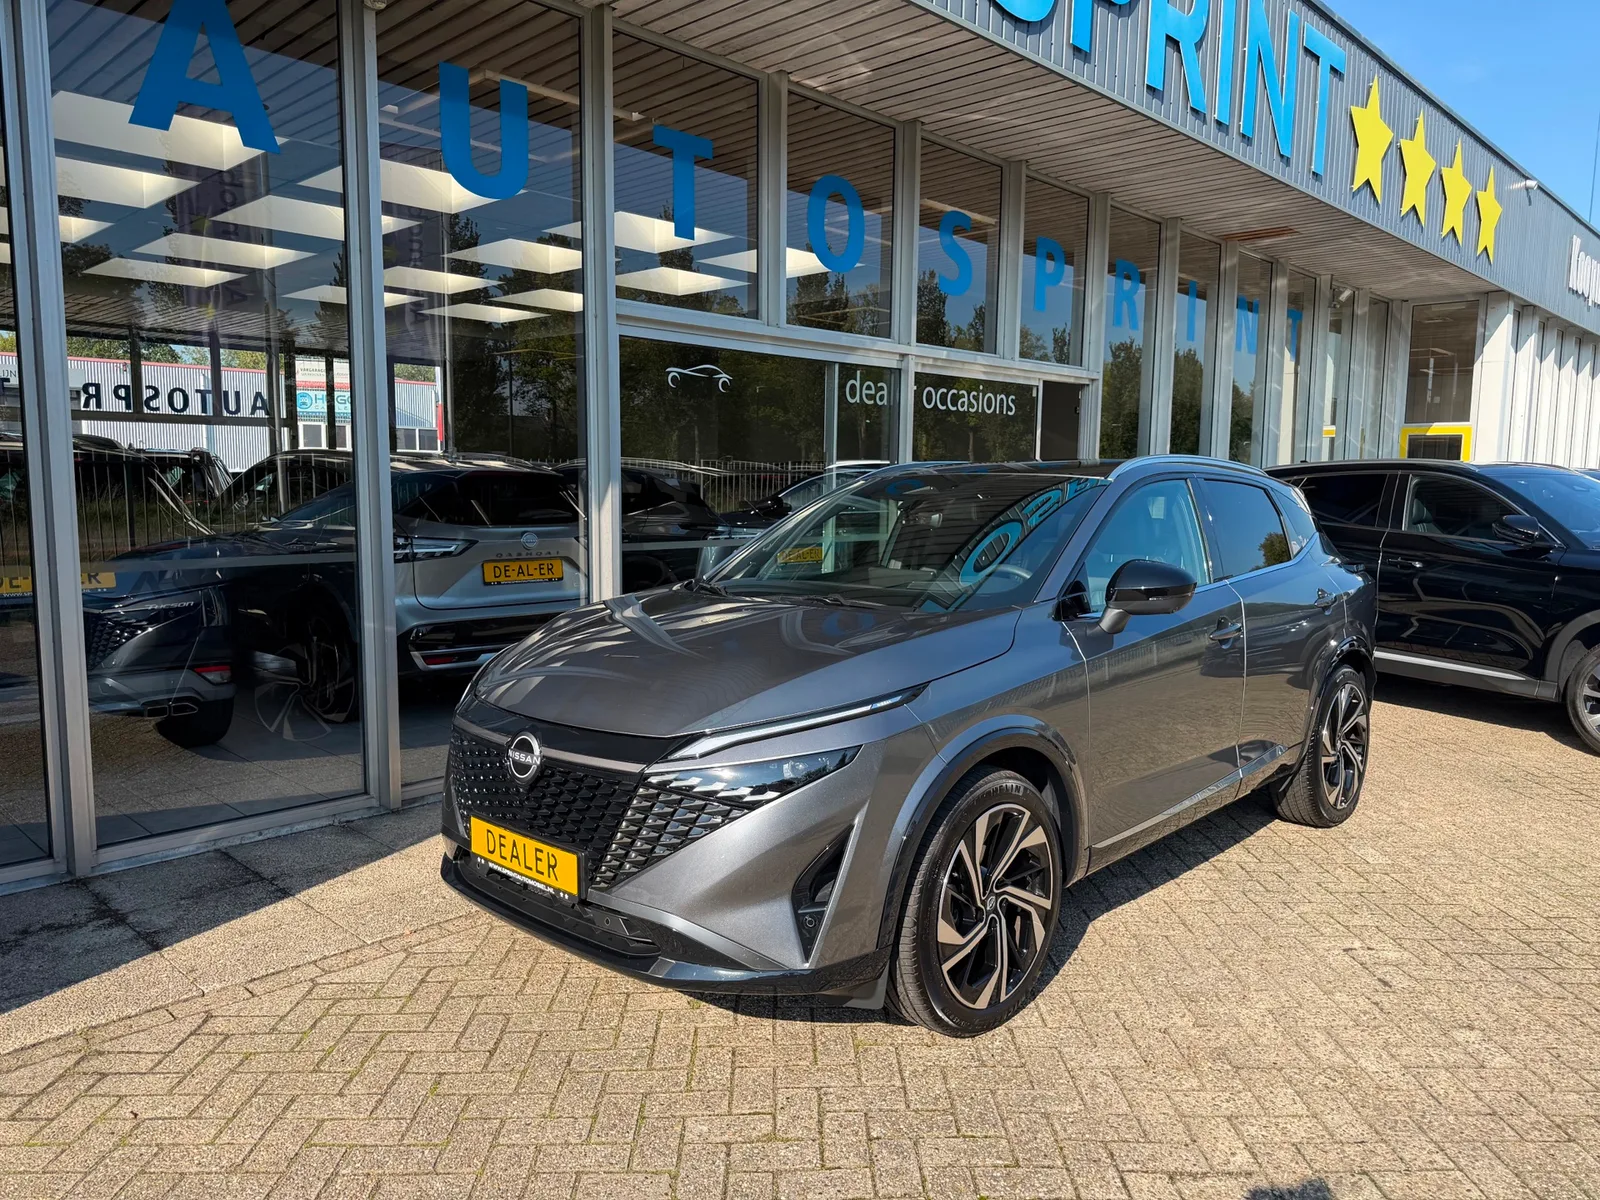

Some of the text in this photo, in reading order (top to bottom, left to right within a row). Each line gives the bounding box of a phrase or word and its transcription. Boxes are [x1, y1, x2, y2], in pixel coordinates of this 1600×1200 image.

[996, 0, 1345, 176] RINT
[923, 385, 1015, 415] occasions
[493, 563, 555, 578] DE-AL-ER
[508, 749, 541, 765] NISSAN
[486, 829, 559, 882] DEALER
